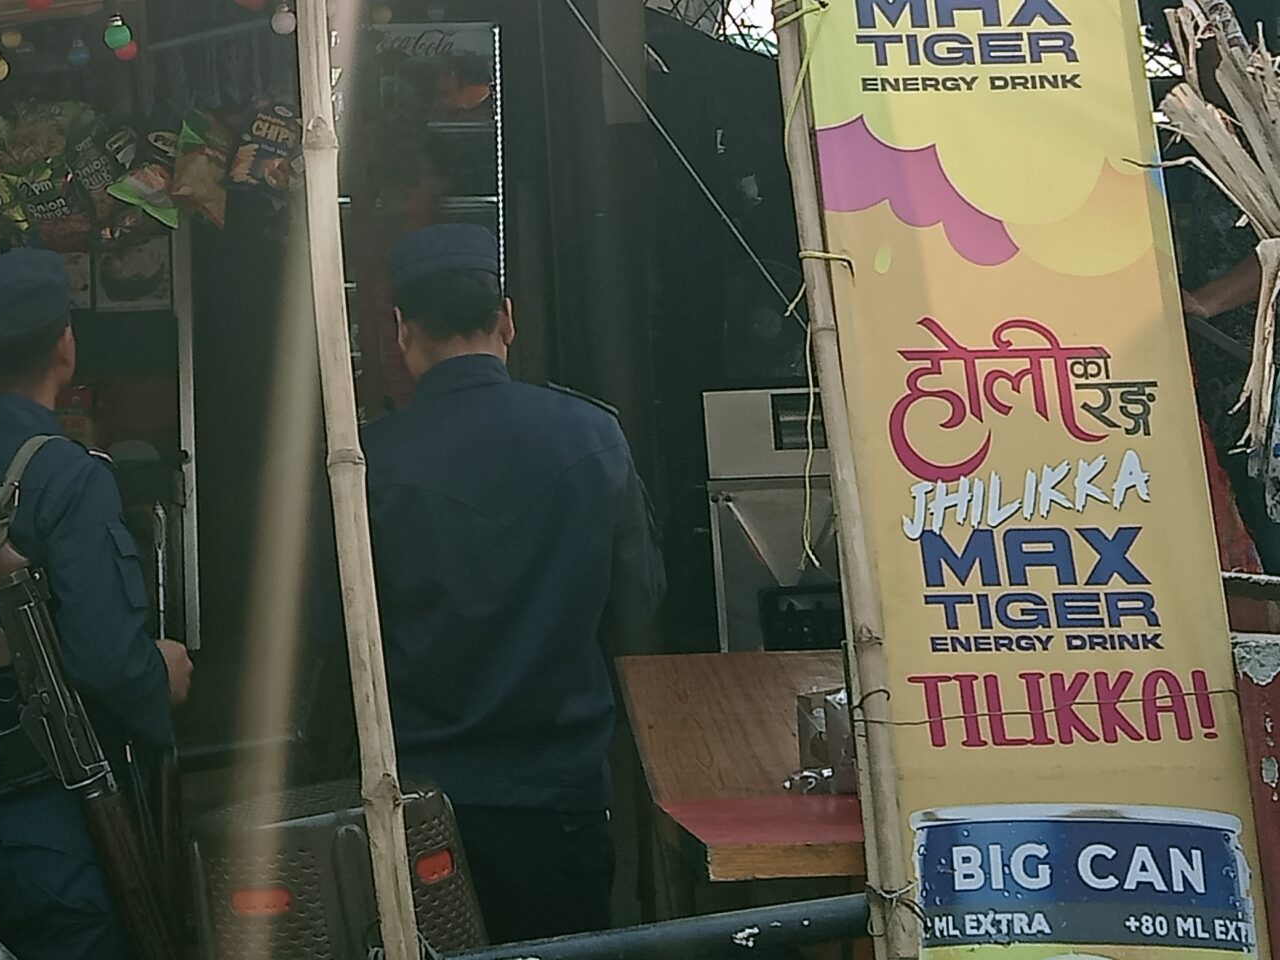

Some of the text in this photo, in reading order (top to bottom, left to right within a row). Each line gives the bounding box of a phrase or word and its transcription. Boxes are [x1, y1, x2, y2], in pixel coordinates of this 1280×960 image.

[856, 31, 1080, 66] TIGER
[861, 74, 1082, 92] ENERGY DRINK
[888, 316, 1109, 482] होली
[902, 450, 1151, 540] JHILIKKA
[921, 526, 1151, 587] MAX
[924, 592, 1161, 630] TIGER
[930, 633, 1164, 653] ENERGY DRINK
[907, 669, 1219, 748] TILIKKA!
[951, 843, 1207, 895] BIG CAN
[934, 909, 1052, 938] ML EXTRA
[1125, 915, 1168, 936] +80
[1176, 916, 1209, 939] ML
